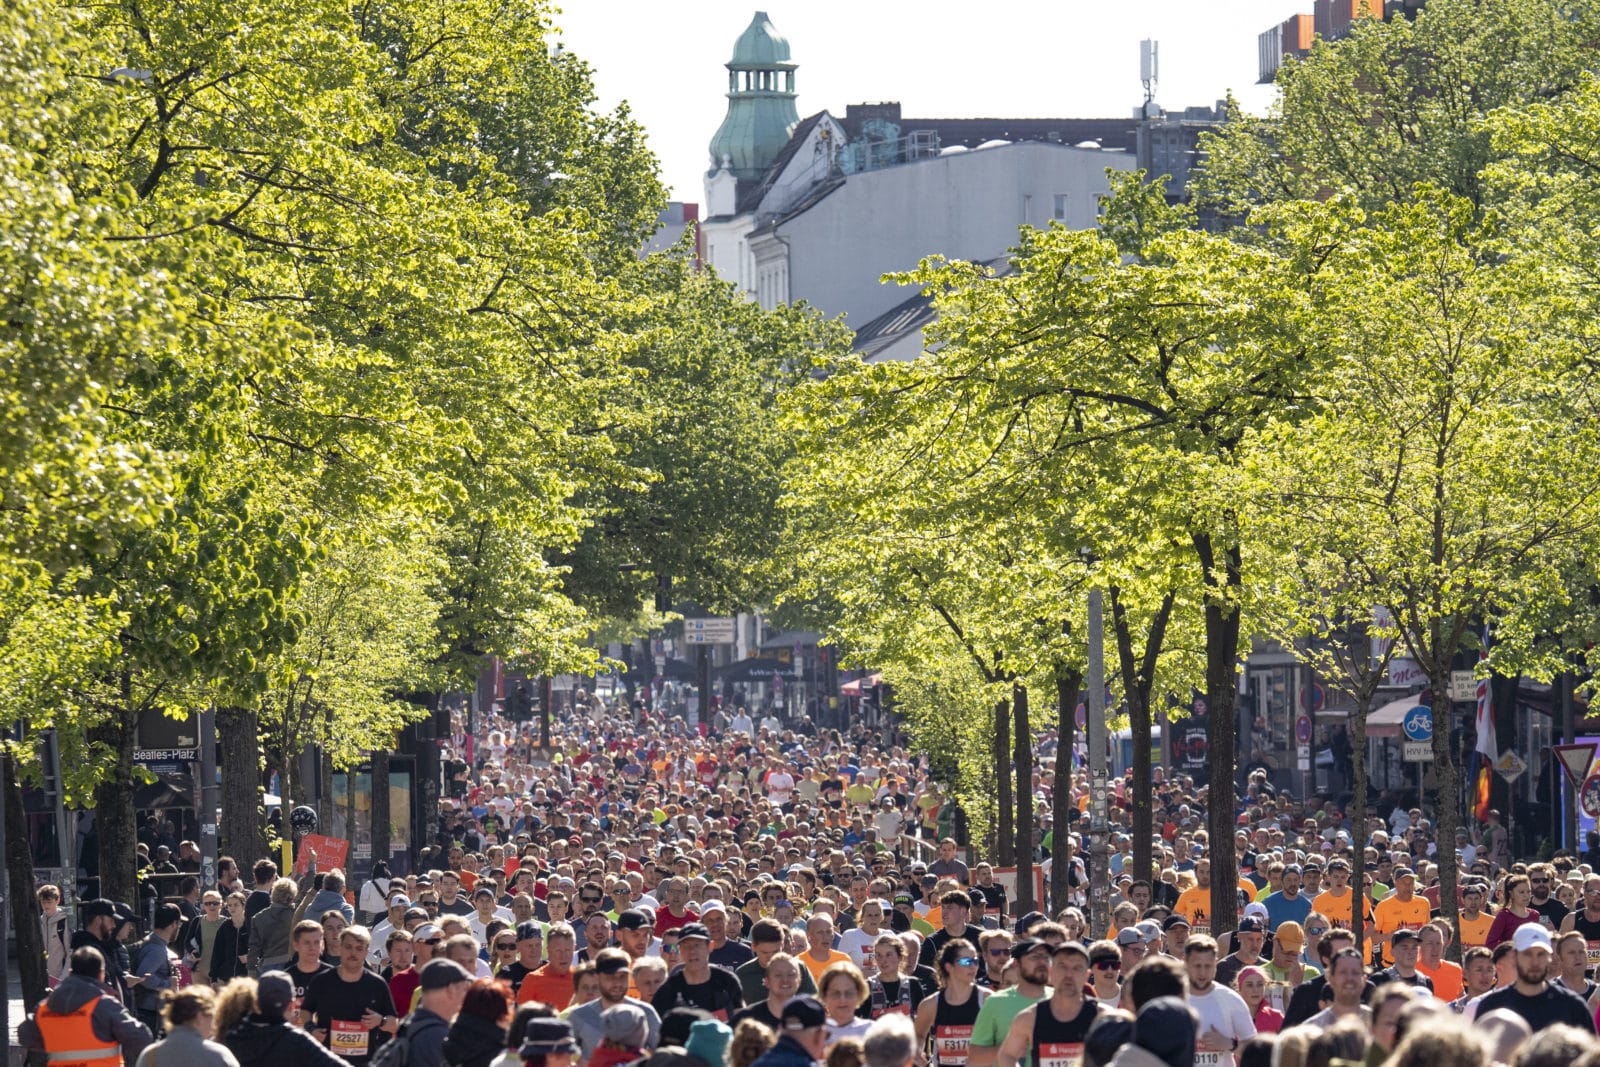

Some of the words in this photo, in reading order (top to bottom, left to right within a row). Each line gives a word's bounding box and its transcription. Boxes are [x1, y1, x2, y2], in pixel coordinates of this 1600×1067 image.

[133, 750, 195, 760] Beatles-Platz
[1406, 748, 1422, 756] HVV
[335, 1033, 362, 1043] 22527
